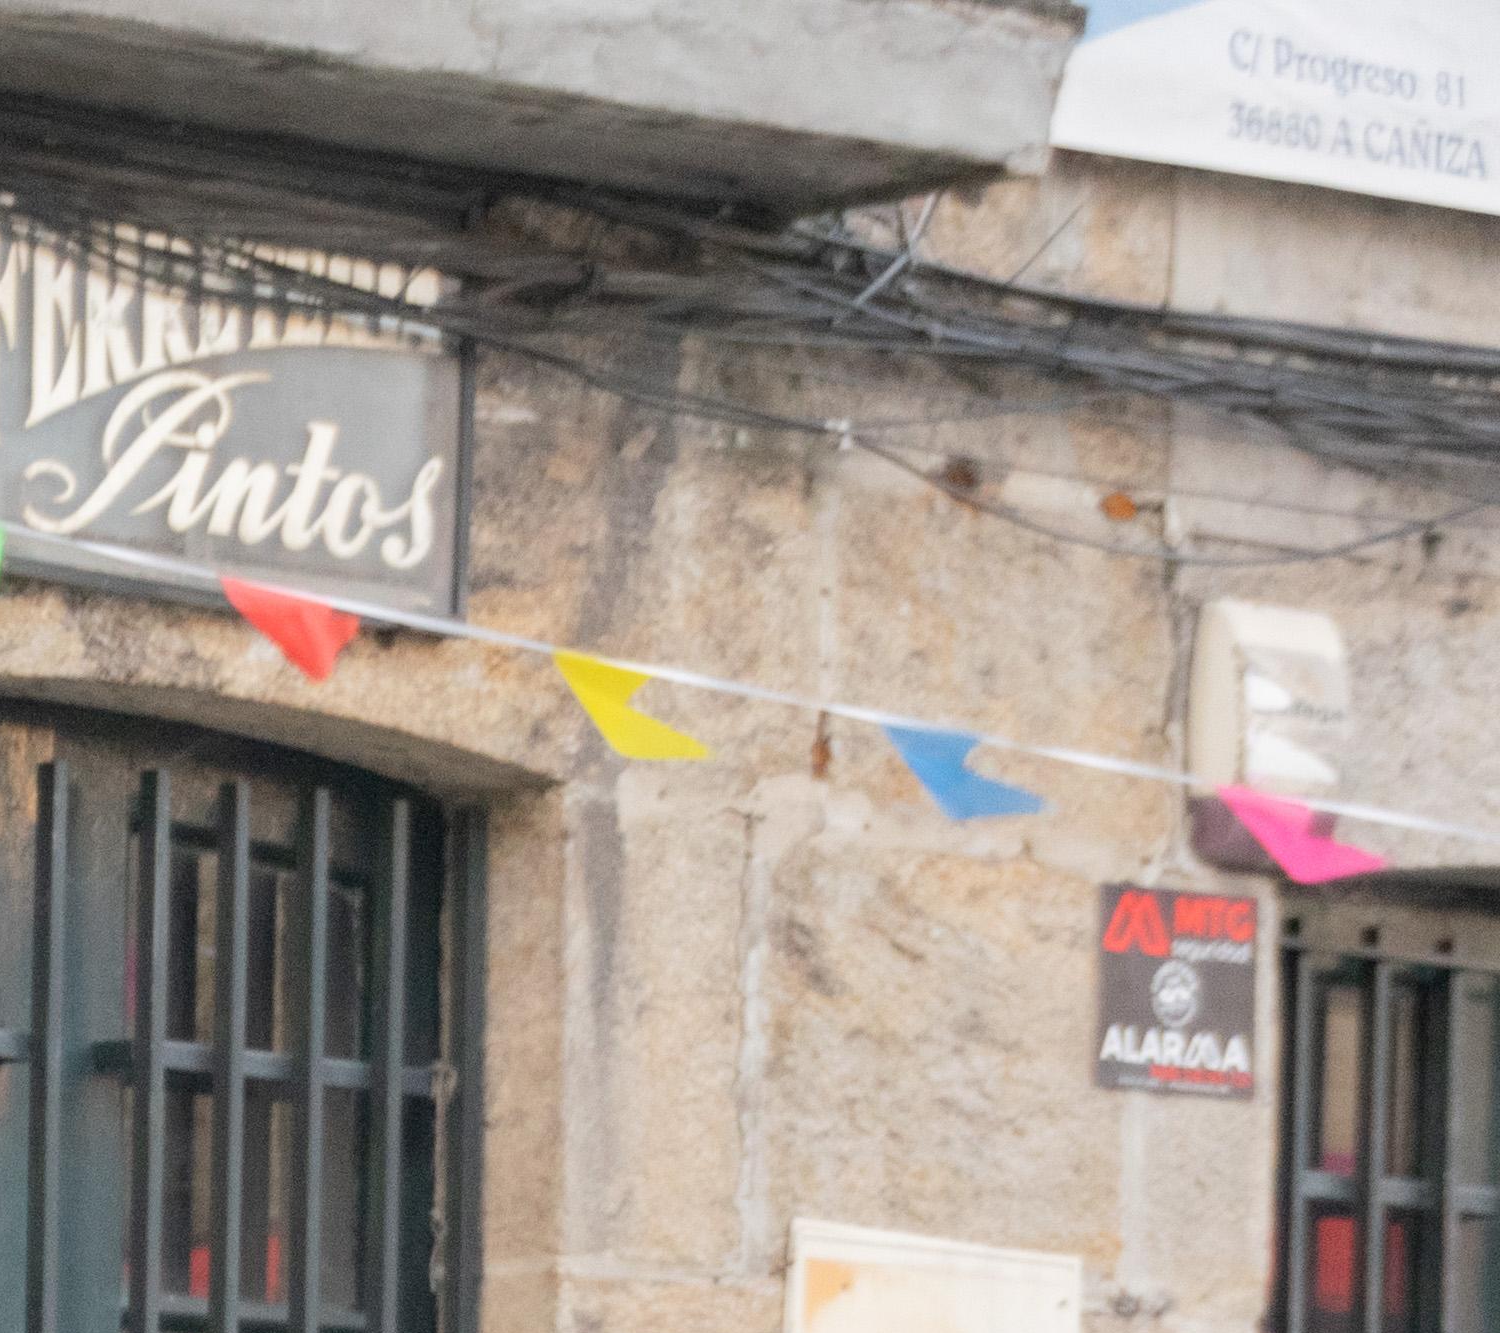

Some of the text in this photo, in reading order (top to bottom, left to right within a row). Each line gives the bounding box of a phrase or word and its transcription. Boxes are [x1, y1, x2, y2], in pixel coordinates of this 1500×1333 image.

[1274, 36, 1417, 98] Progreso
[1434, 69, 1466, 108] 81
[1362, 117, 1488, 180] CAÑIZA
[23, 369, 445, 570] Pintos
[1100, 1023, 1250, 1073] ALARMA
